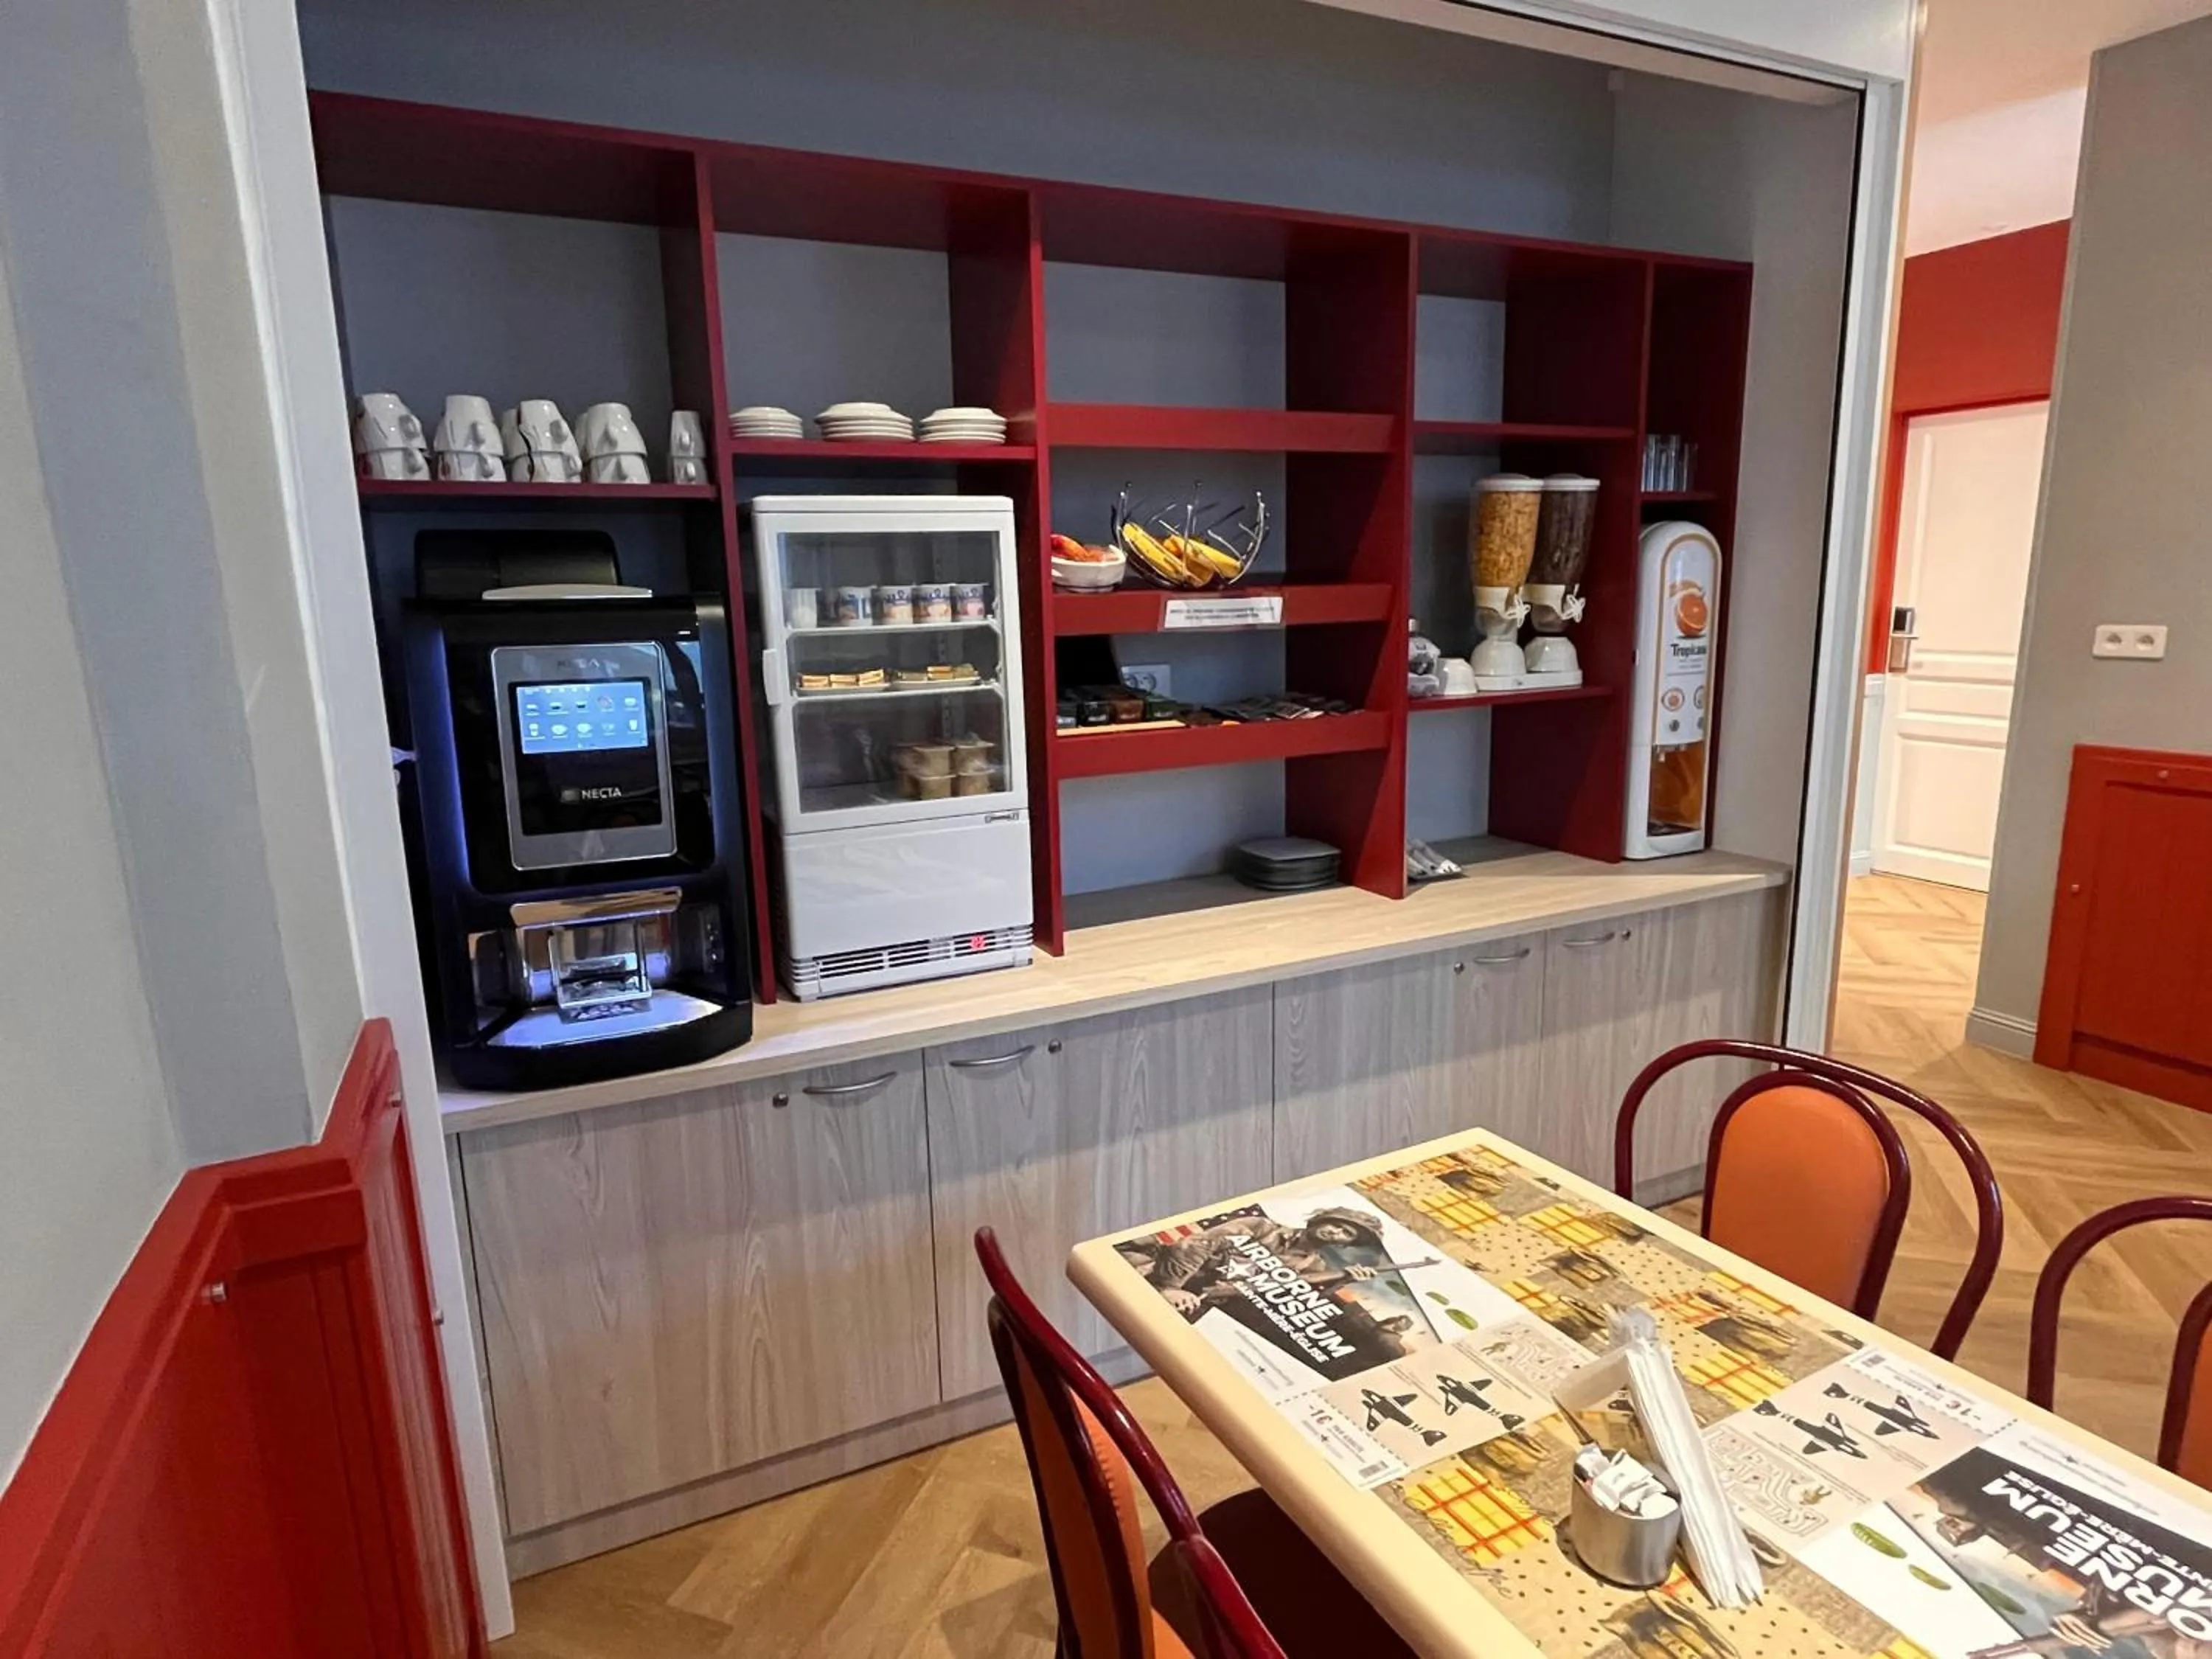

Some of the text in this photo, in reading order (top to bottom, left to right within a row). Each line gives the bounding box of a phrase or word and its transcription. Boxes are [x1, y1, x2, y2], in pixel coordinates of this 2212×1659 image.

[582, 787, 622, 800] NECTA
[1225, 1235, 1344, 1320] AIRBORNE
[1247, 1273, 1357, 1358] MUSEUM
